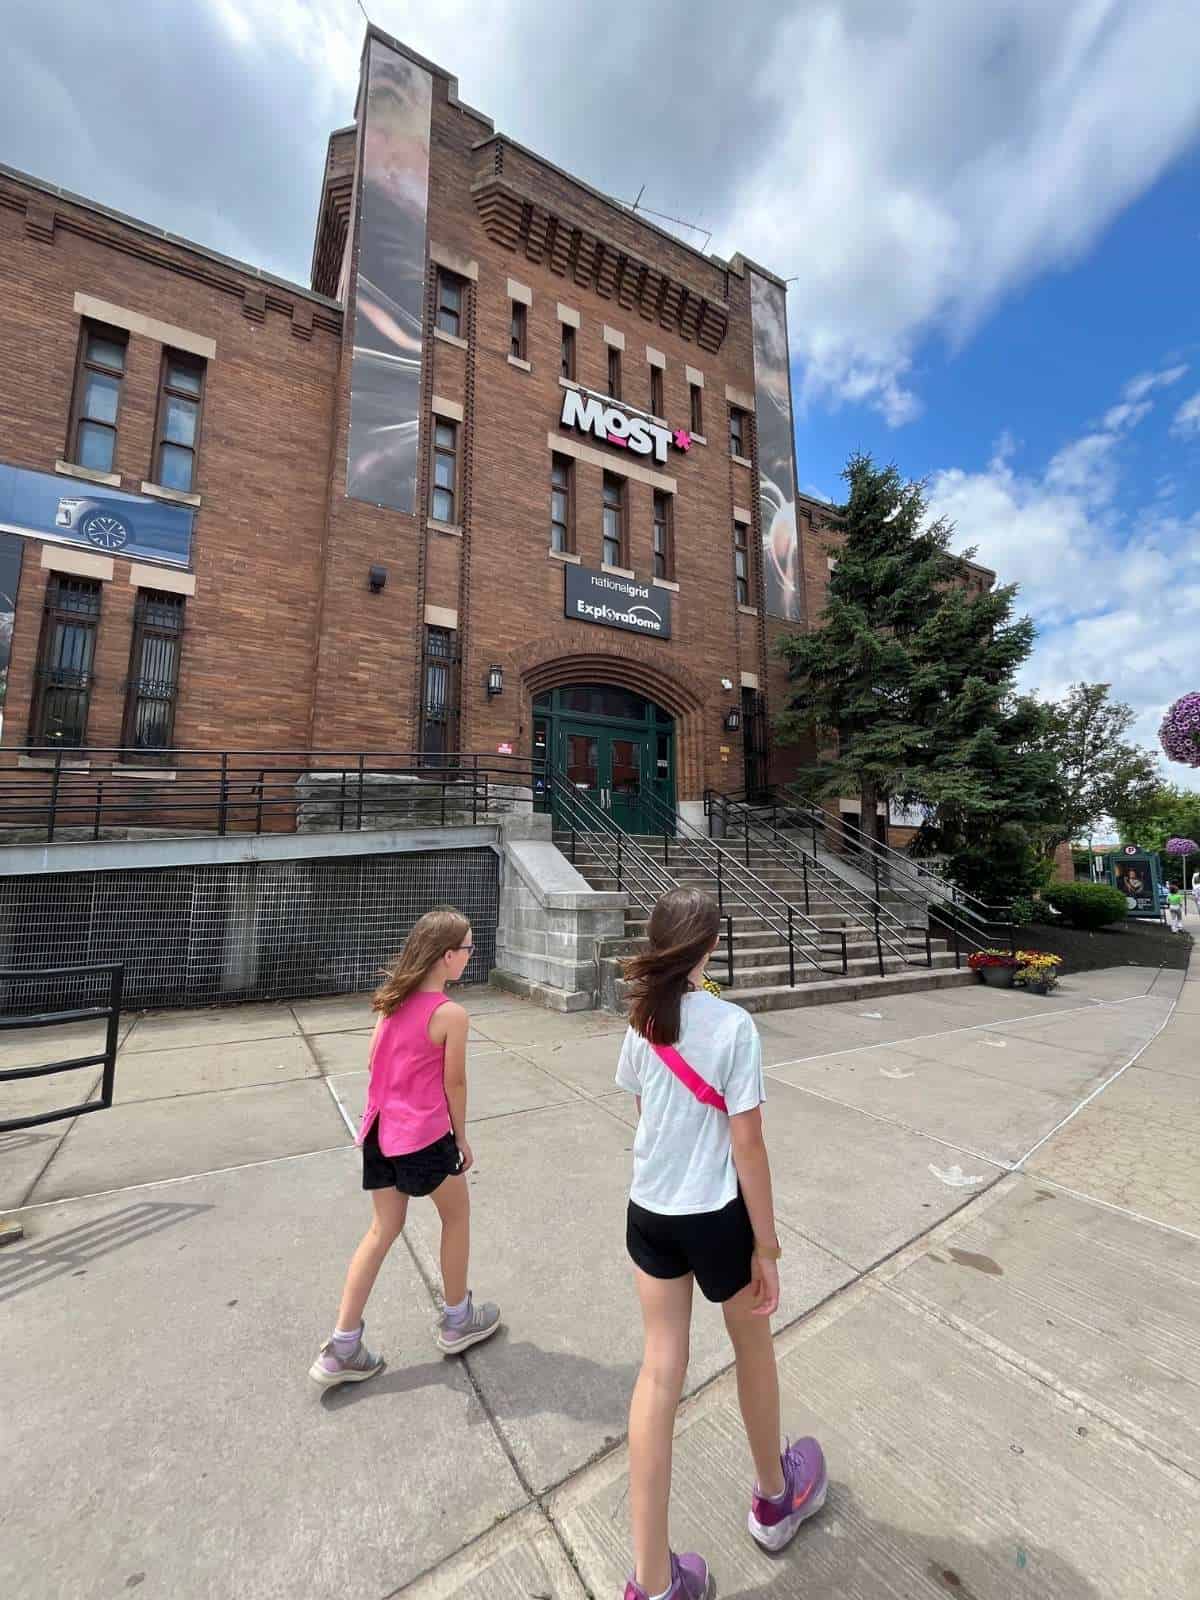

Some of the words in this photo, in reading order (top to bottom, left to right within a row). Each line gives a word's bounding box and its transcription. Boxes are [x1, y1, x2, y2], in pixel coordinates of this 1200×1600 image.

[561, 389, 673, 463] MOST
[591, 576, 649, 599] nationalgrid
[577, 599, 661, 631] ExploraDome
